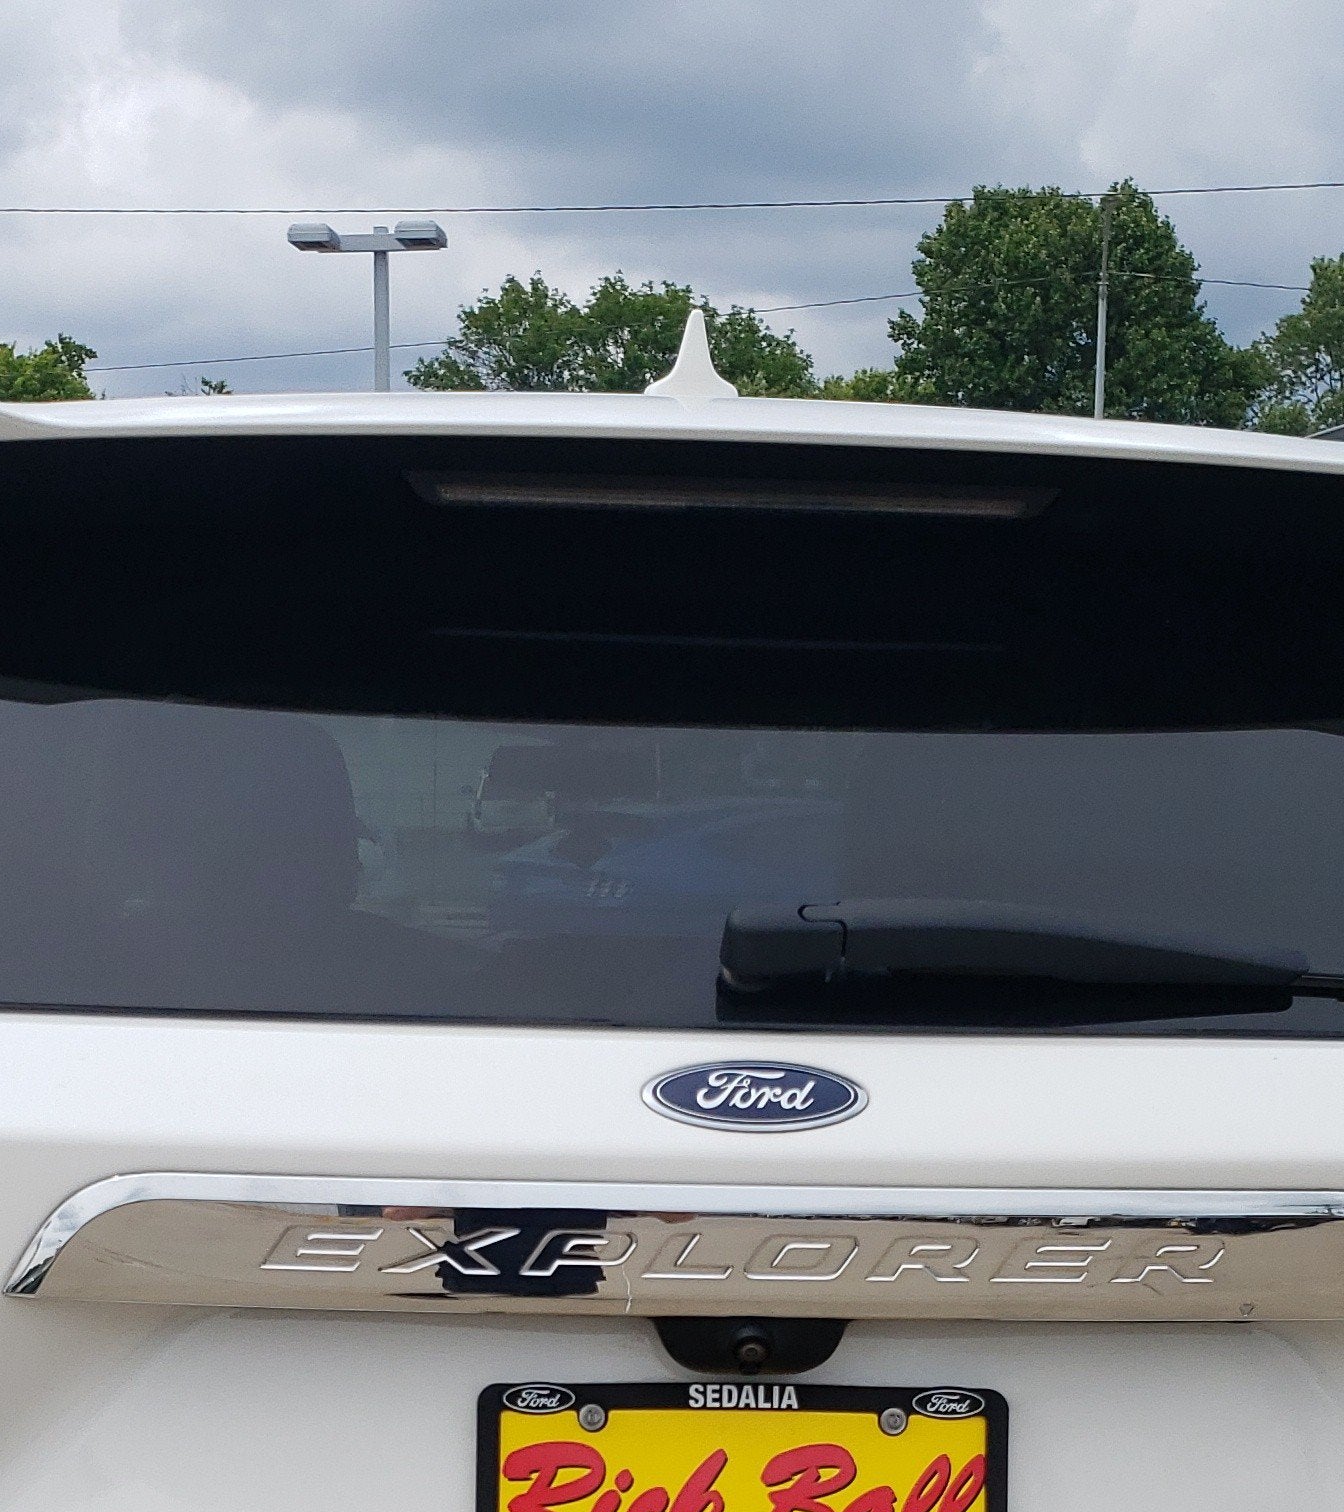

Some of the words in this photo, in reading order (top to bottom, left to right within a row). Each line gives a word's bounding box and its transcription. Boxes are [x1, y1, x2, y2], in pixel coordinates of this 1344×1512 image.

[696, 1069, 817, 1111] Ford
[259, 1225, 1225, 1284] EXPLORER
[517, 1389, 560, 1409] Ford
[688, 1384, 799, 1411] SEDALIA
[926, 1394, 971, 1413] Ford
